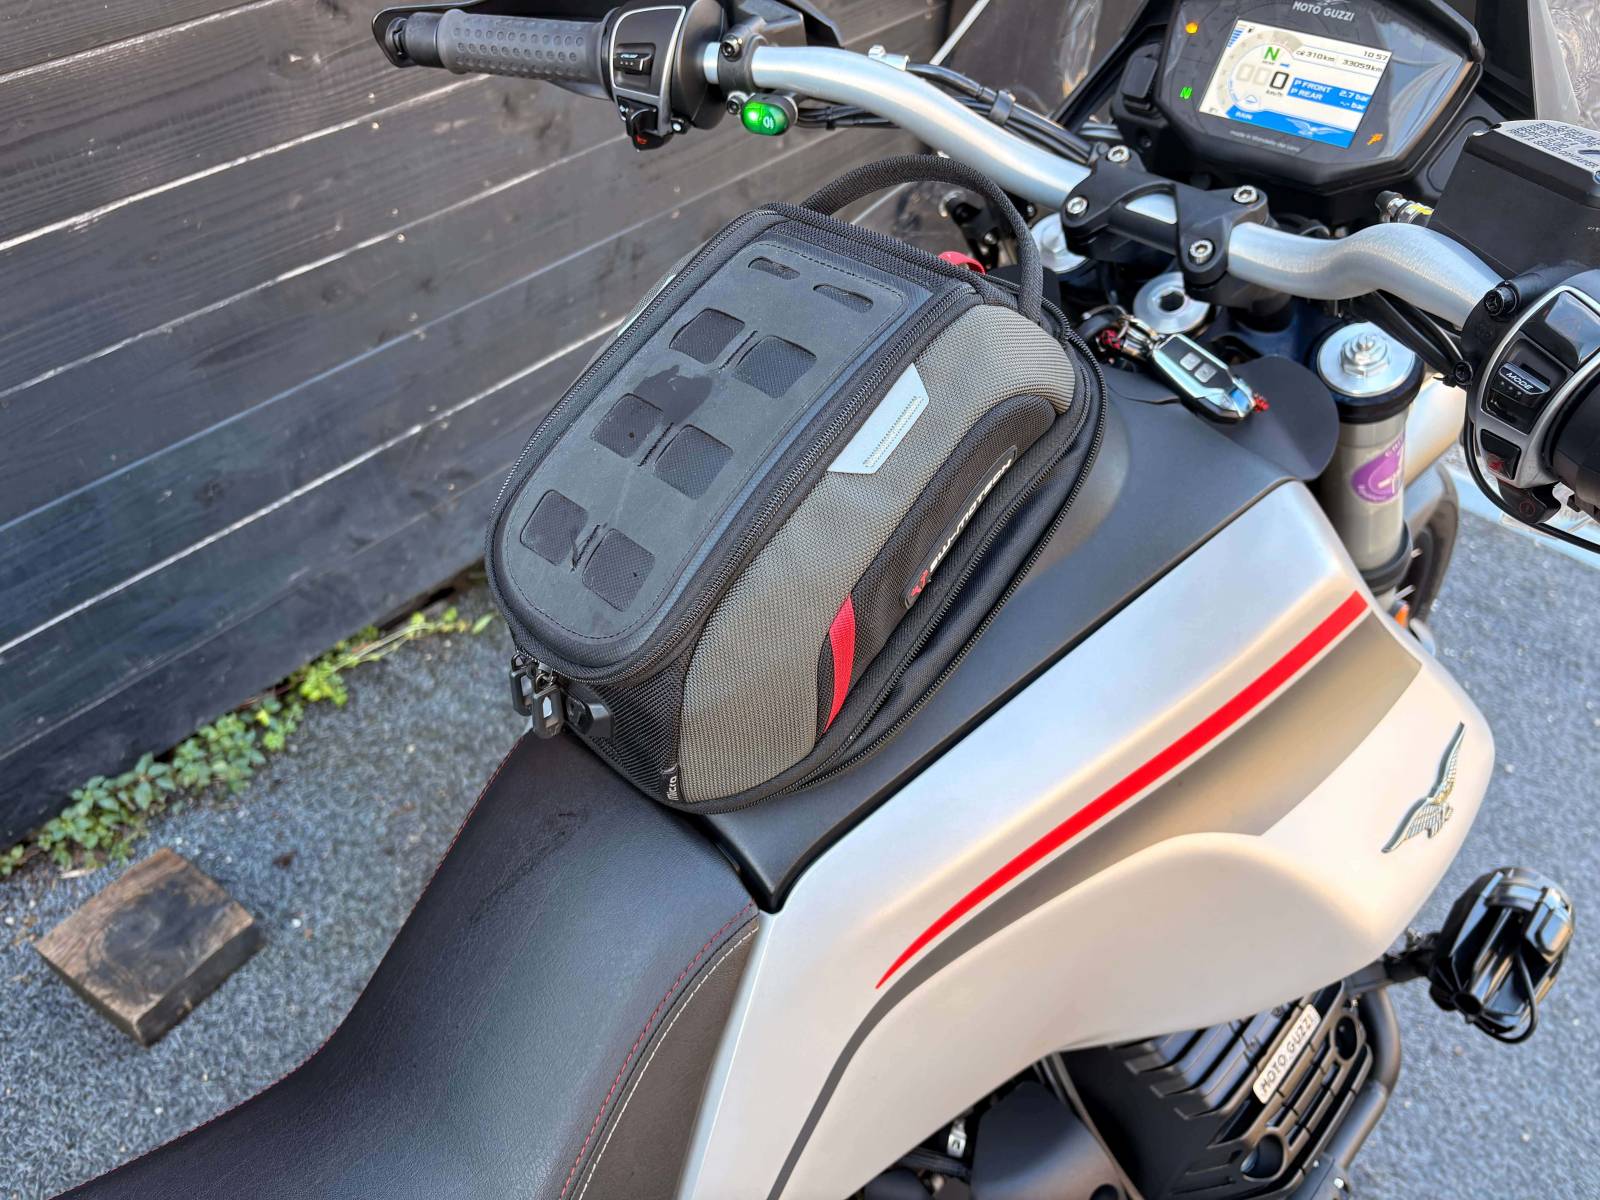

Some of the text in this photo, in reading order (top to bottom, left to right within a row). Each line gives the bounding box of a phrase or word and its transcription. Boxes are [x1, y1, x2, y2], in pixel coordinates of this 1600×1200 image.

[1292, 1, 1355, 22] MOTO GUZZI
[1264, 46, 1280, 60] N
[1298, 89, 1323, 100] REAR
[1350, 102, 1366, 110] bar
[1302, 81, 1332, 93] FRONT
[1339, 90, 1354, 99] 2.7
[1355, 92, 1371, 102] bar
[1506, 372, 1534, 390] MODE
[1260, 1015, 1313, 1093] MOTO GUZZI
